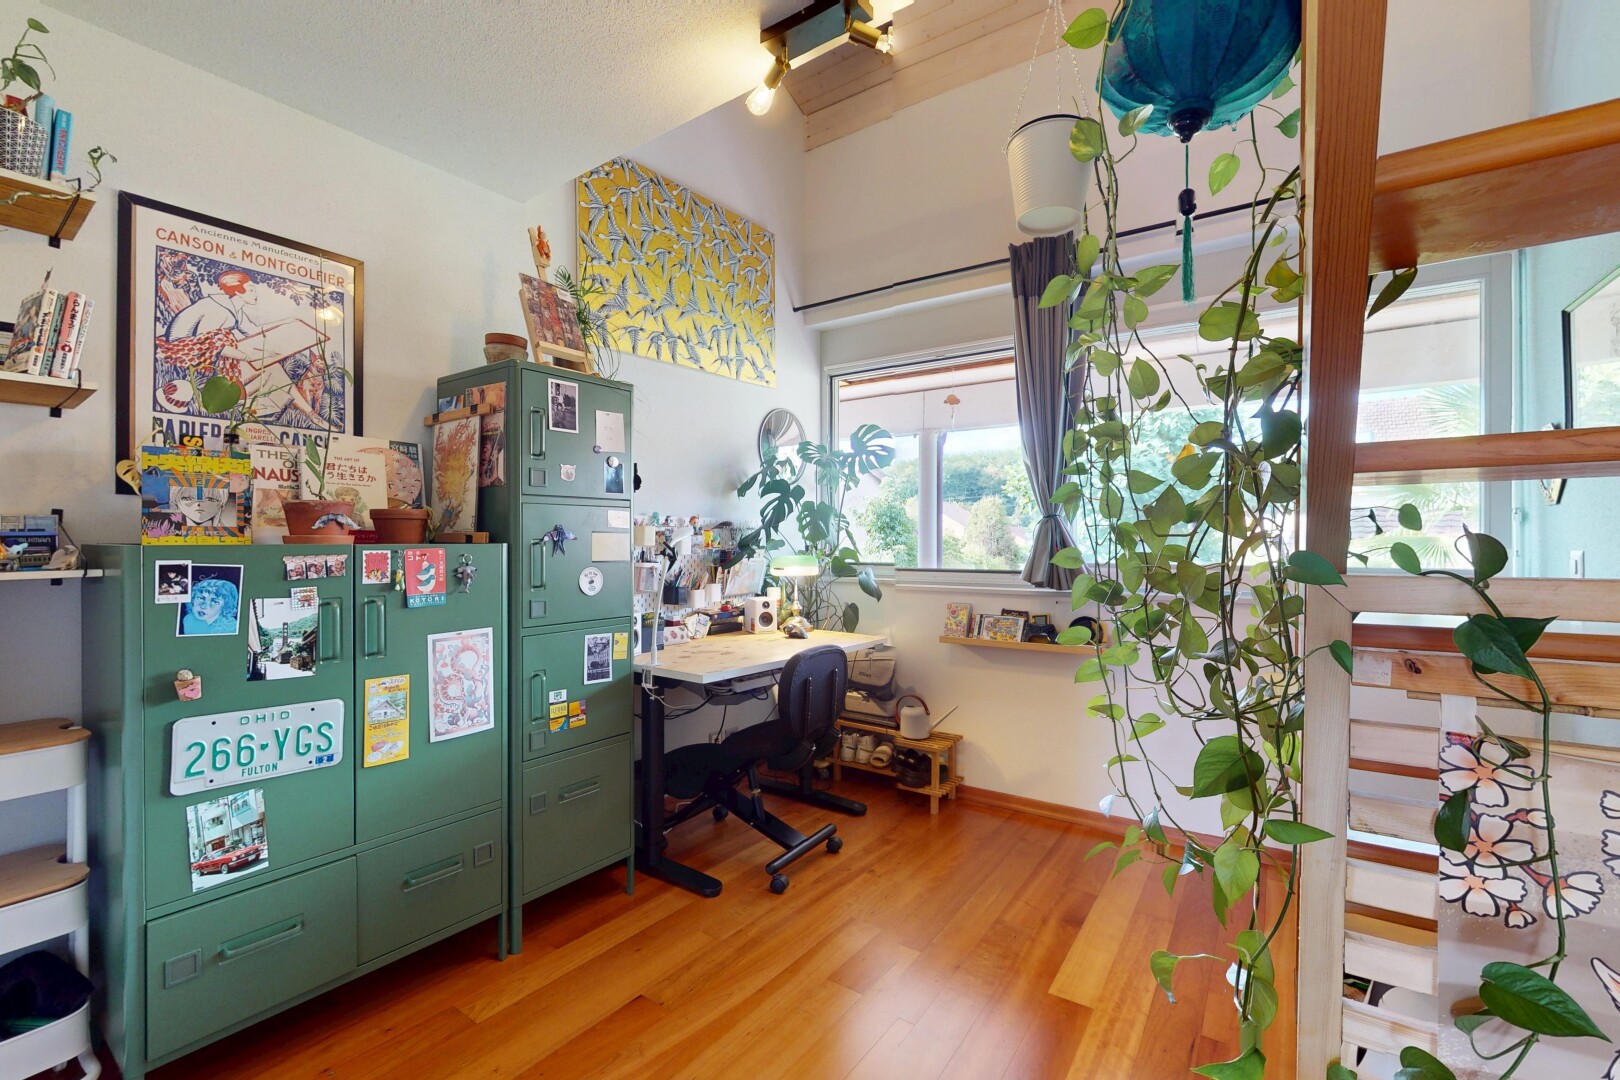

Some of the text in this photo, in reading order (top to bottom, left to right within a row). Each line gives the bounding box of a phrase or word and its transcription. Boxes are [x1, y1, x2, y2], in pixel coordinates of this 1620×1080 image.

[189, 224, 320, 267] Anciennes Manufactures
[155, 227, 346, 288] CANSON & MONTGOLFIER
[152, 416, 230, 447] PAPIER
[245, 427, 271, 435] INGRES
[256, 450, 289, 460] THE
[326, 471, 377, 483] う生きるか
[410, 595, 444, 604] KOTORI
[240, 710, 292, 726] OHIO
[241, 762, 278, 777] FULTON
